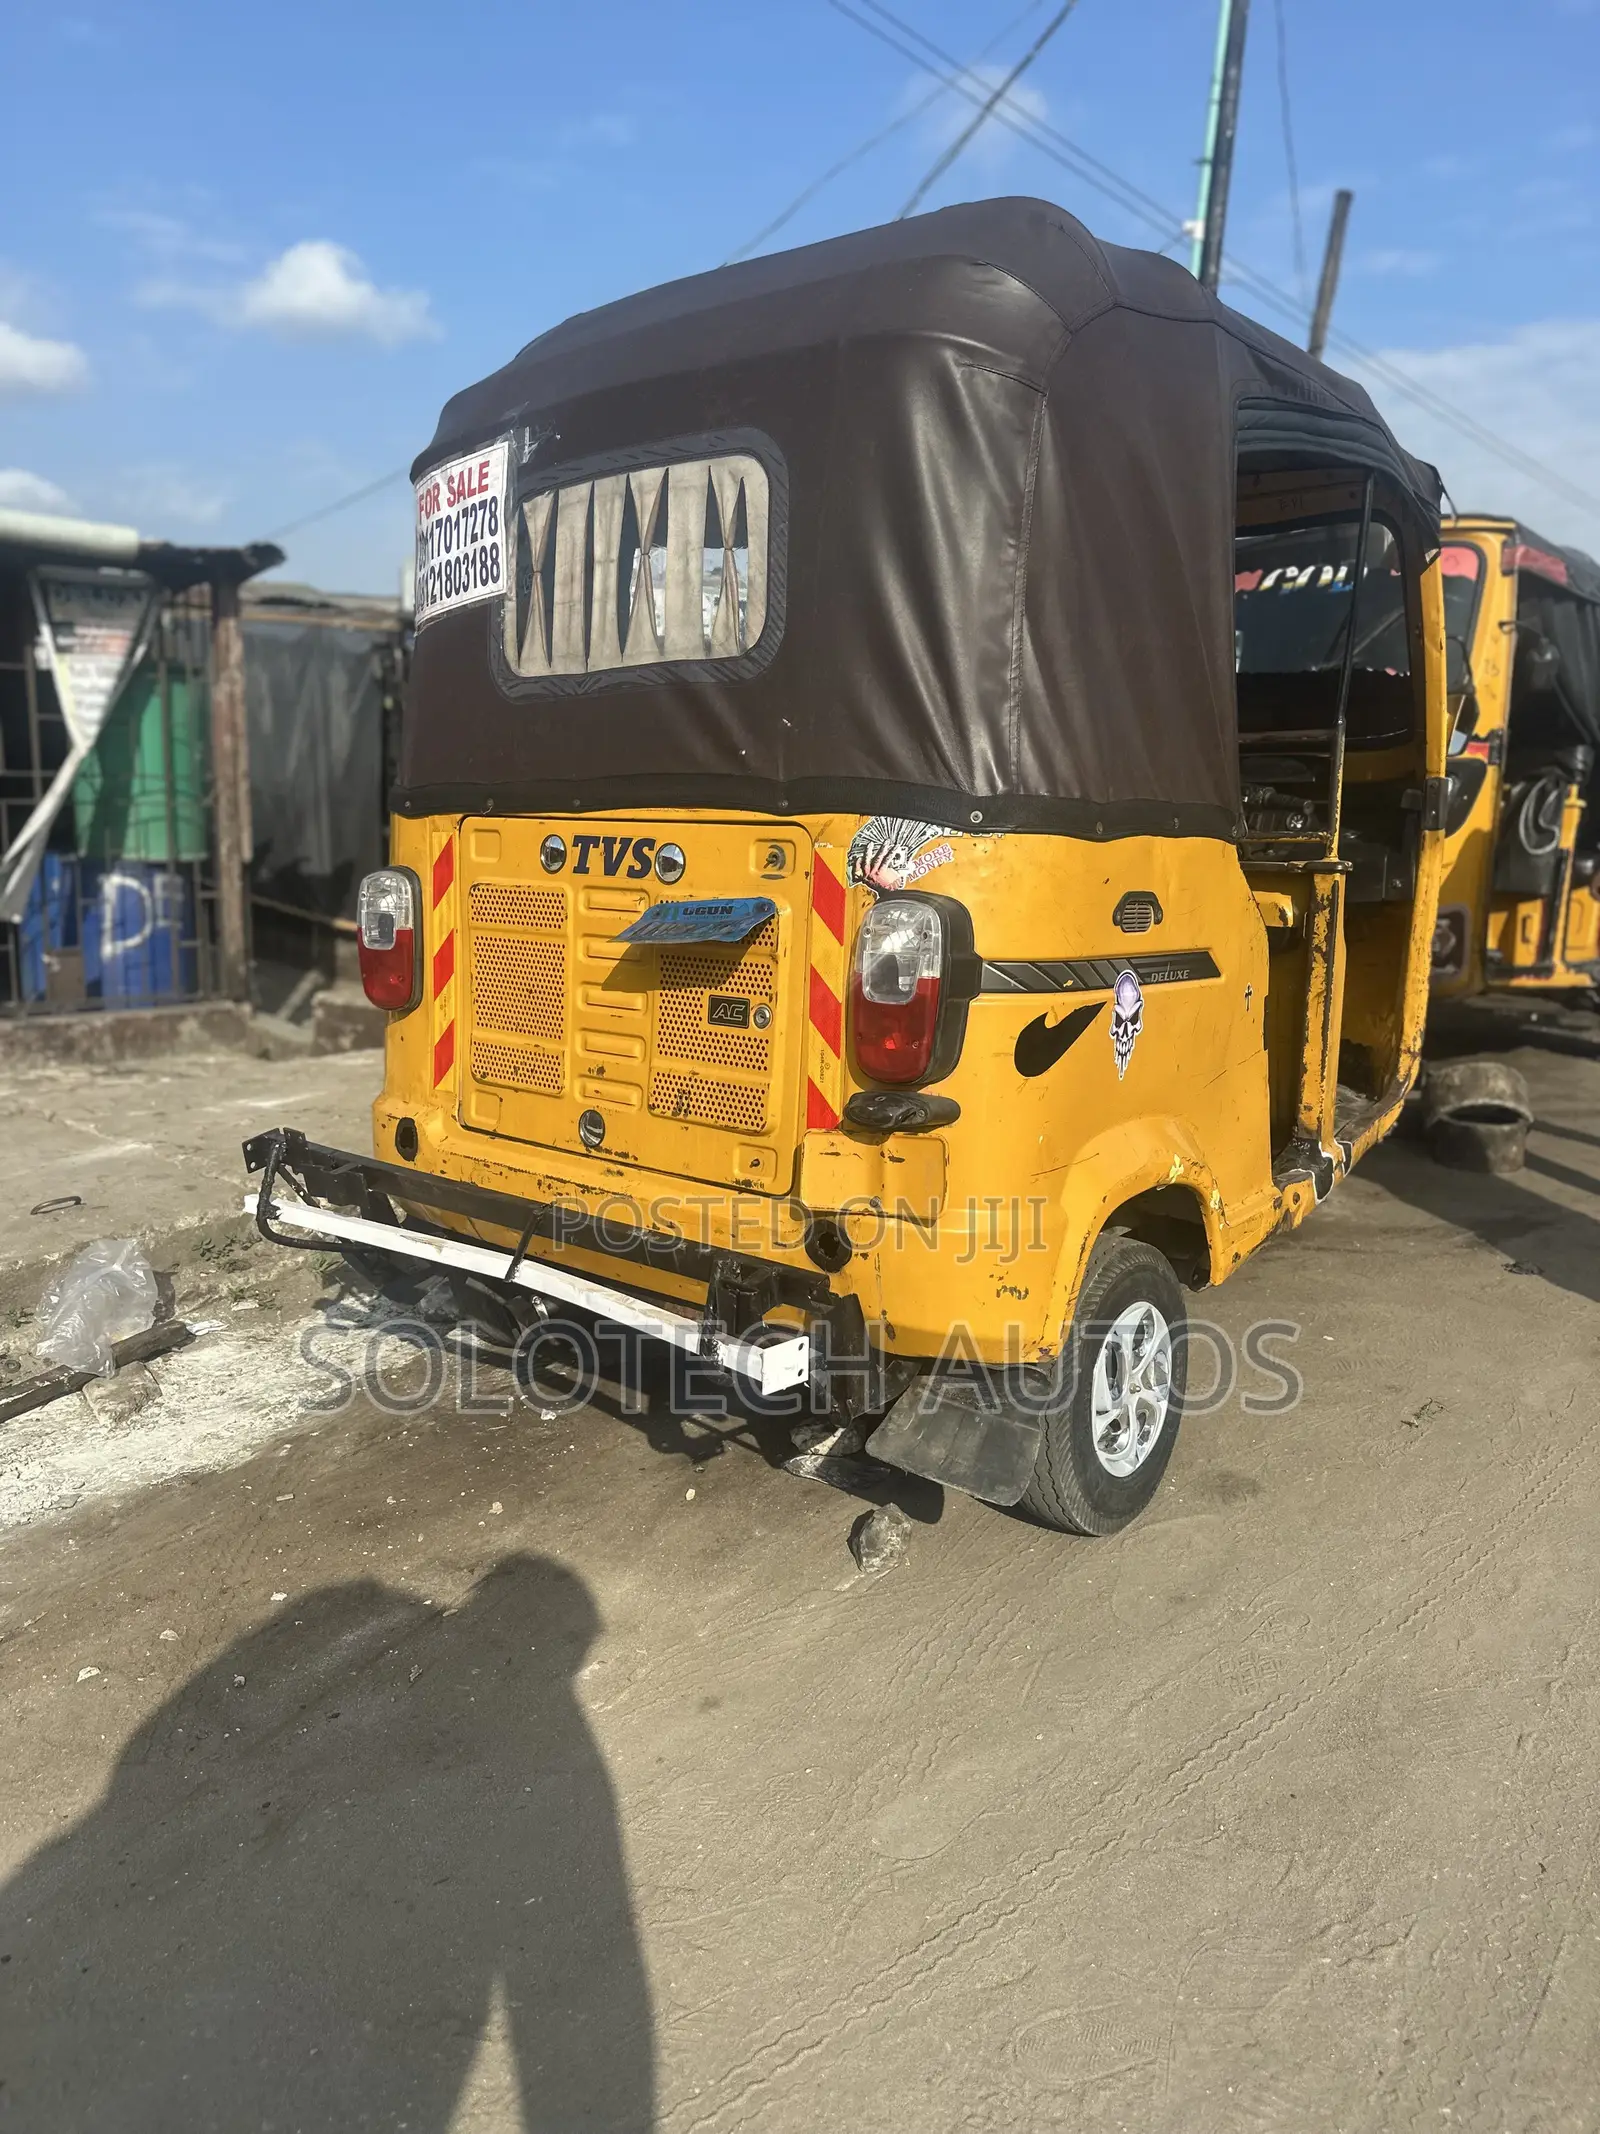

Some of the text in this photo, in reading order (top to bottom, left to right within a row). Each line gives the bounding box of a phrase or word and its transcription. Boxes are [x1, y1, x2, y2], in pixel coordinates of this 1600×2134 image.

[418, 460, 490, 521] FOR SALE
[571, 834, 656, 879] TVS
[907, 853, 953, 882] MONEY
[913, 844, 951, 869] MORE
[1150, 969, 1190, 983] DELUXE
[713, 1003, 746, 1021] AC
